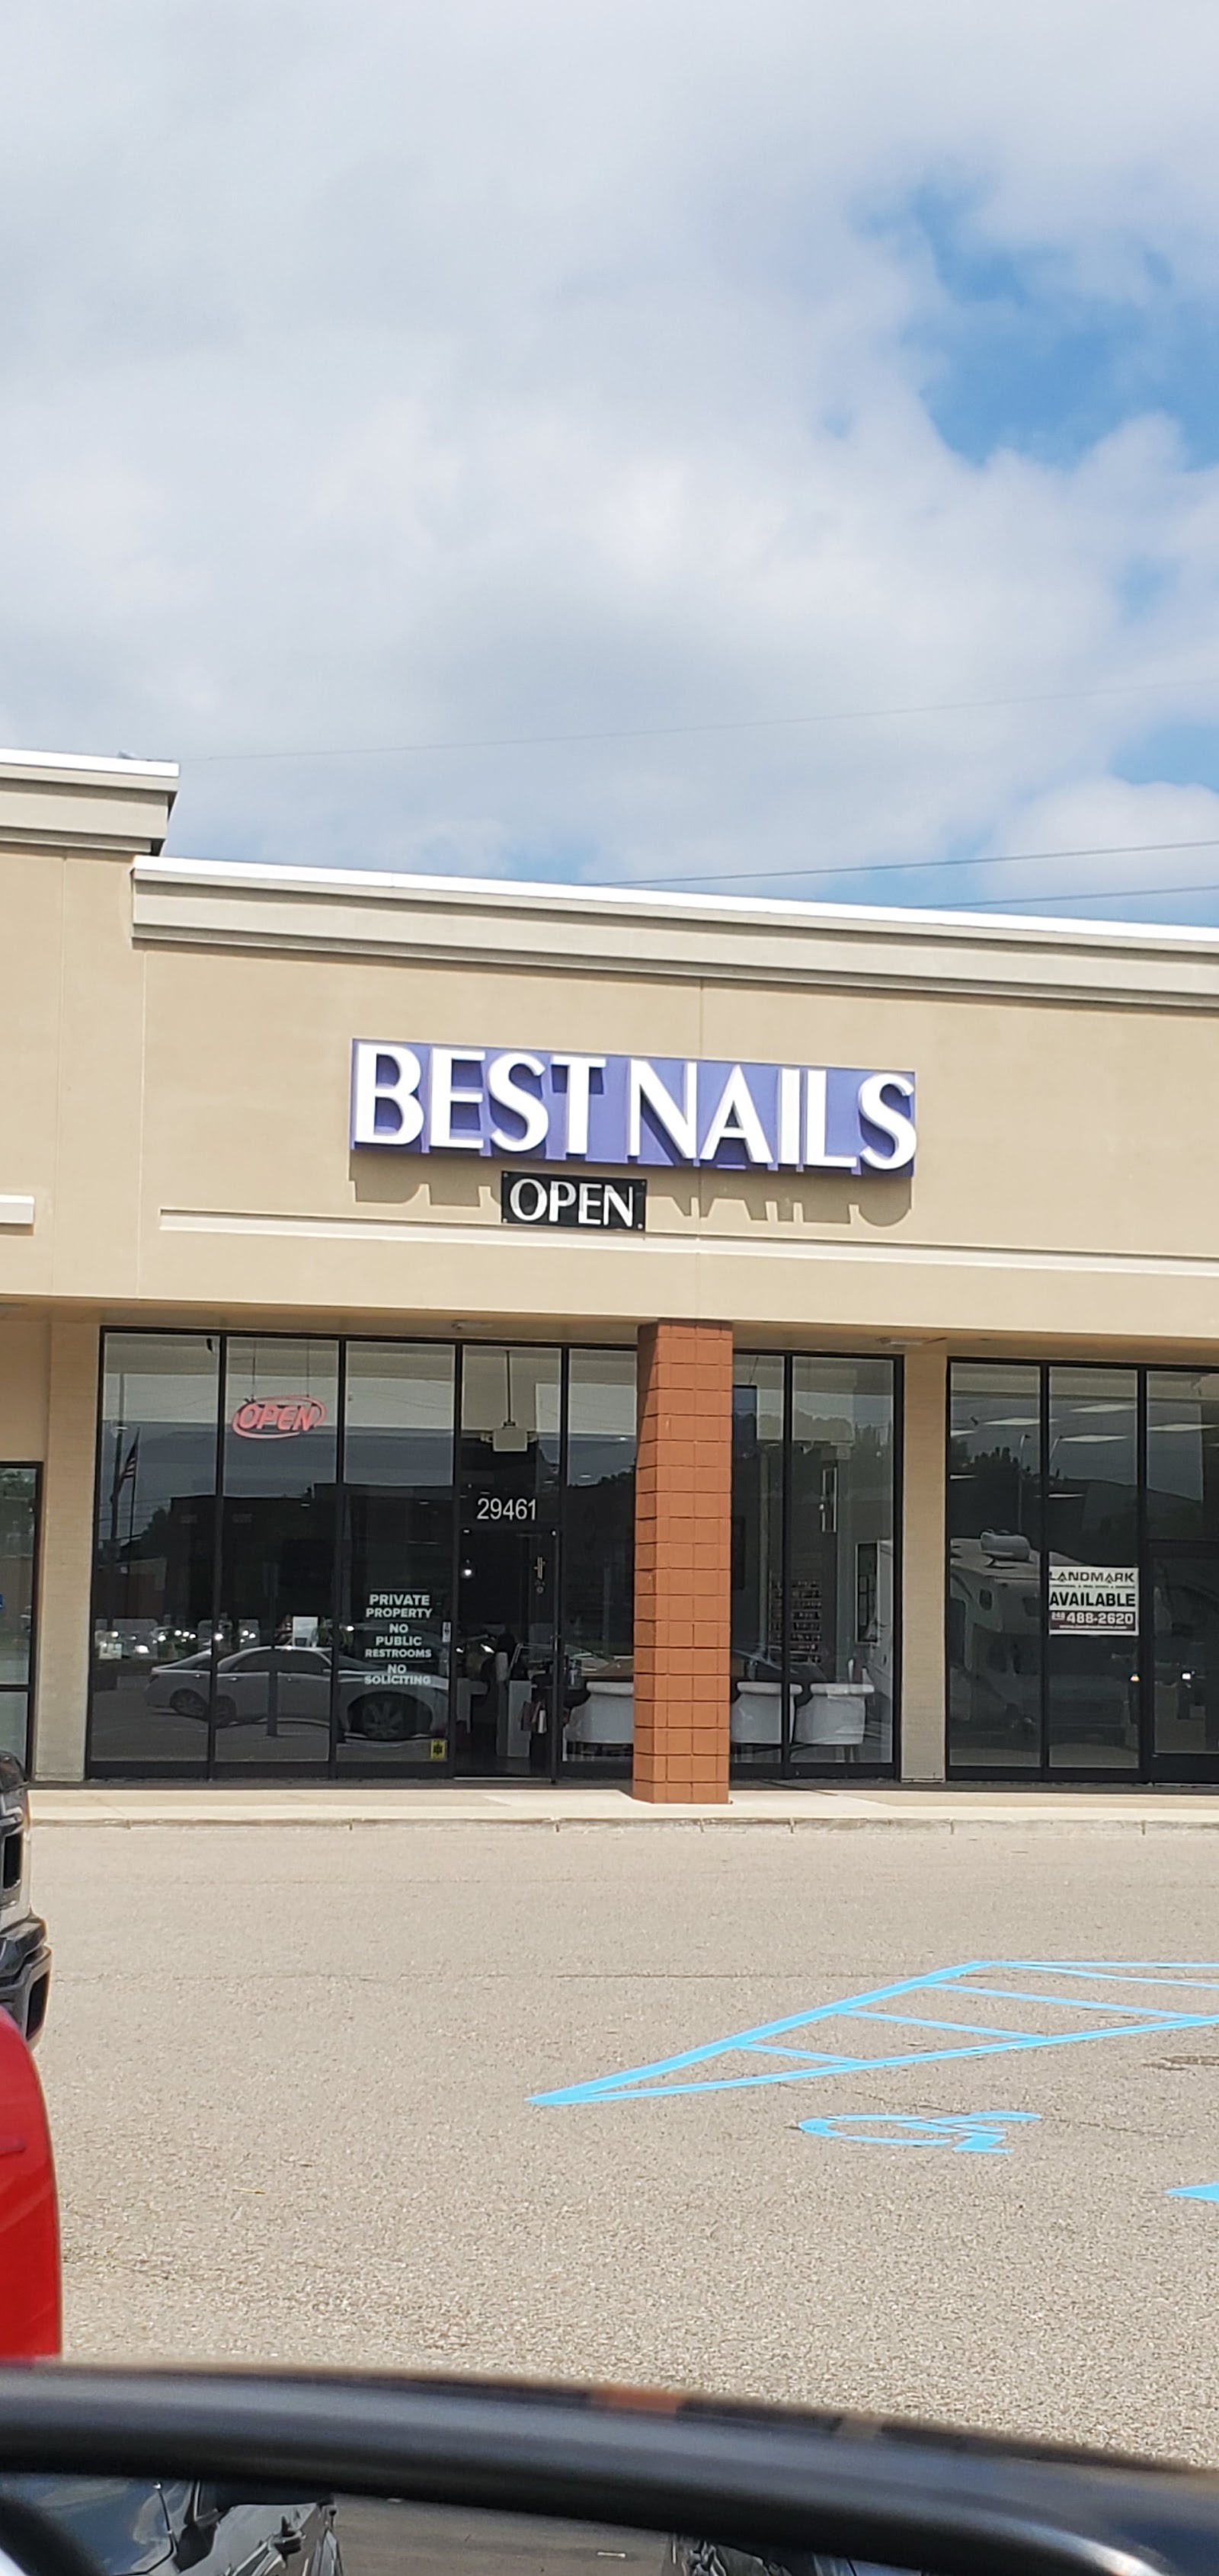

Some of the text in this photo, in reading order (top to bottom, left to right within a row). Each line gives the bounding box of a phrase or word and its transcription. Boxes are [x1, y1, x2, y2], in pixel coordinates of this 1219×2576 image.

[354, 1043, 917, 1171] BEST NAILS
[509, 1178, 633, 1227] OPEN
[238, 1403, 317, 1432] OPEN
[476, 1497, 536, 1521] 29461
[1049, 1572, 1134, 1583] LANDMARK
[369, 1594, 430, 1606] PRIVATE
[1050, 1592, 1136, 1607] AVAILABLE
[366, 1608, 433, 1618] PROPERTY
[389, 1623, 409, 1634] NO
[376, 1636, 423, 1646] PUBLIC
[365, 1648, 432, 1658] RESTROOMS
[387, 1663, 407, 1674] NO
[364, 1675, 432, 1685] SOLICITING
